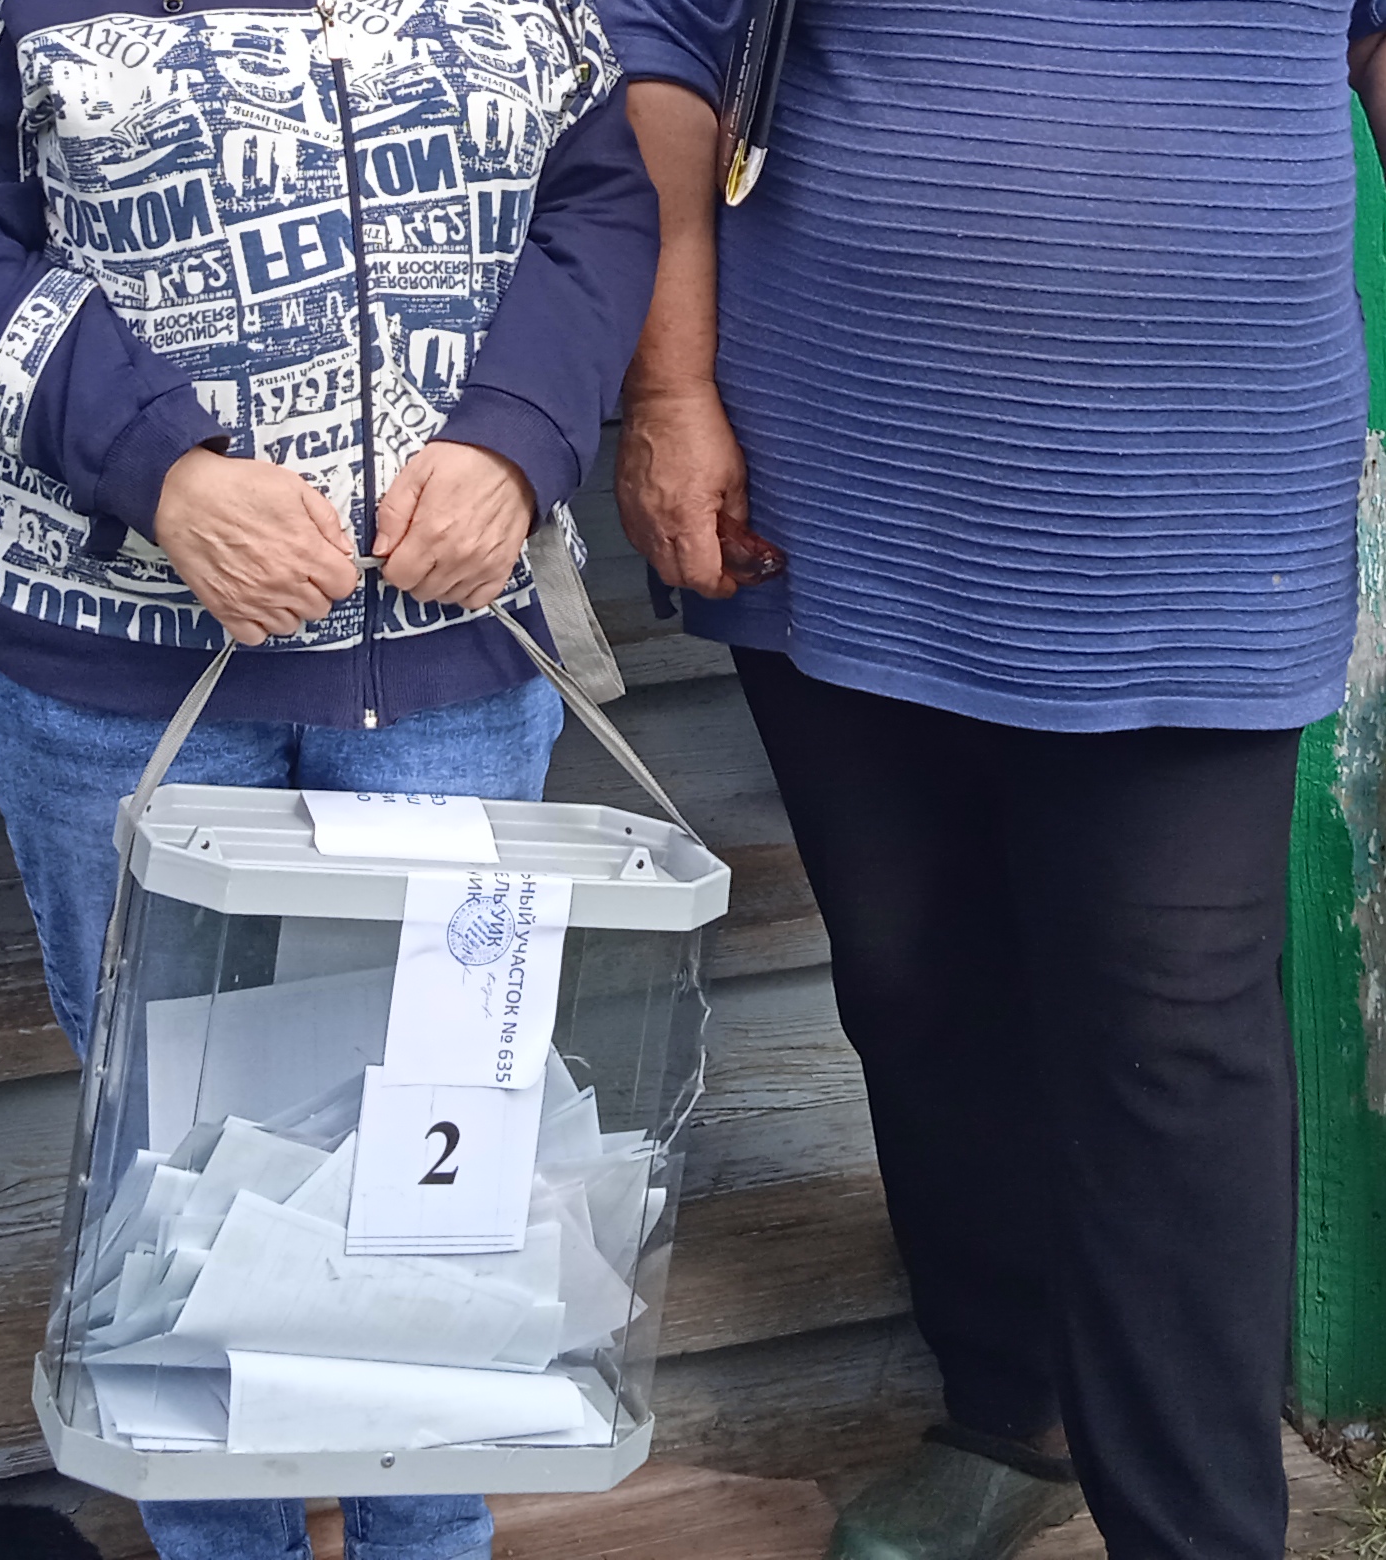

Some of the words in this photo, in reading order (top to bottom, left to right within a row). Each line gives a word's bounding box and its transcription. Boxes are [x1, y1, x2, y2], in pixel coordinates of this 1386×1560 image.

[487, 909, 506, 947] УИК
[504, 929, 531, 1016] УЧАСТОК
[495, 1049, 514, 1083] 635
[417, 1120, 462, 1186] 2
